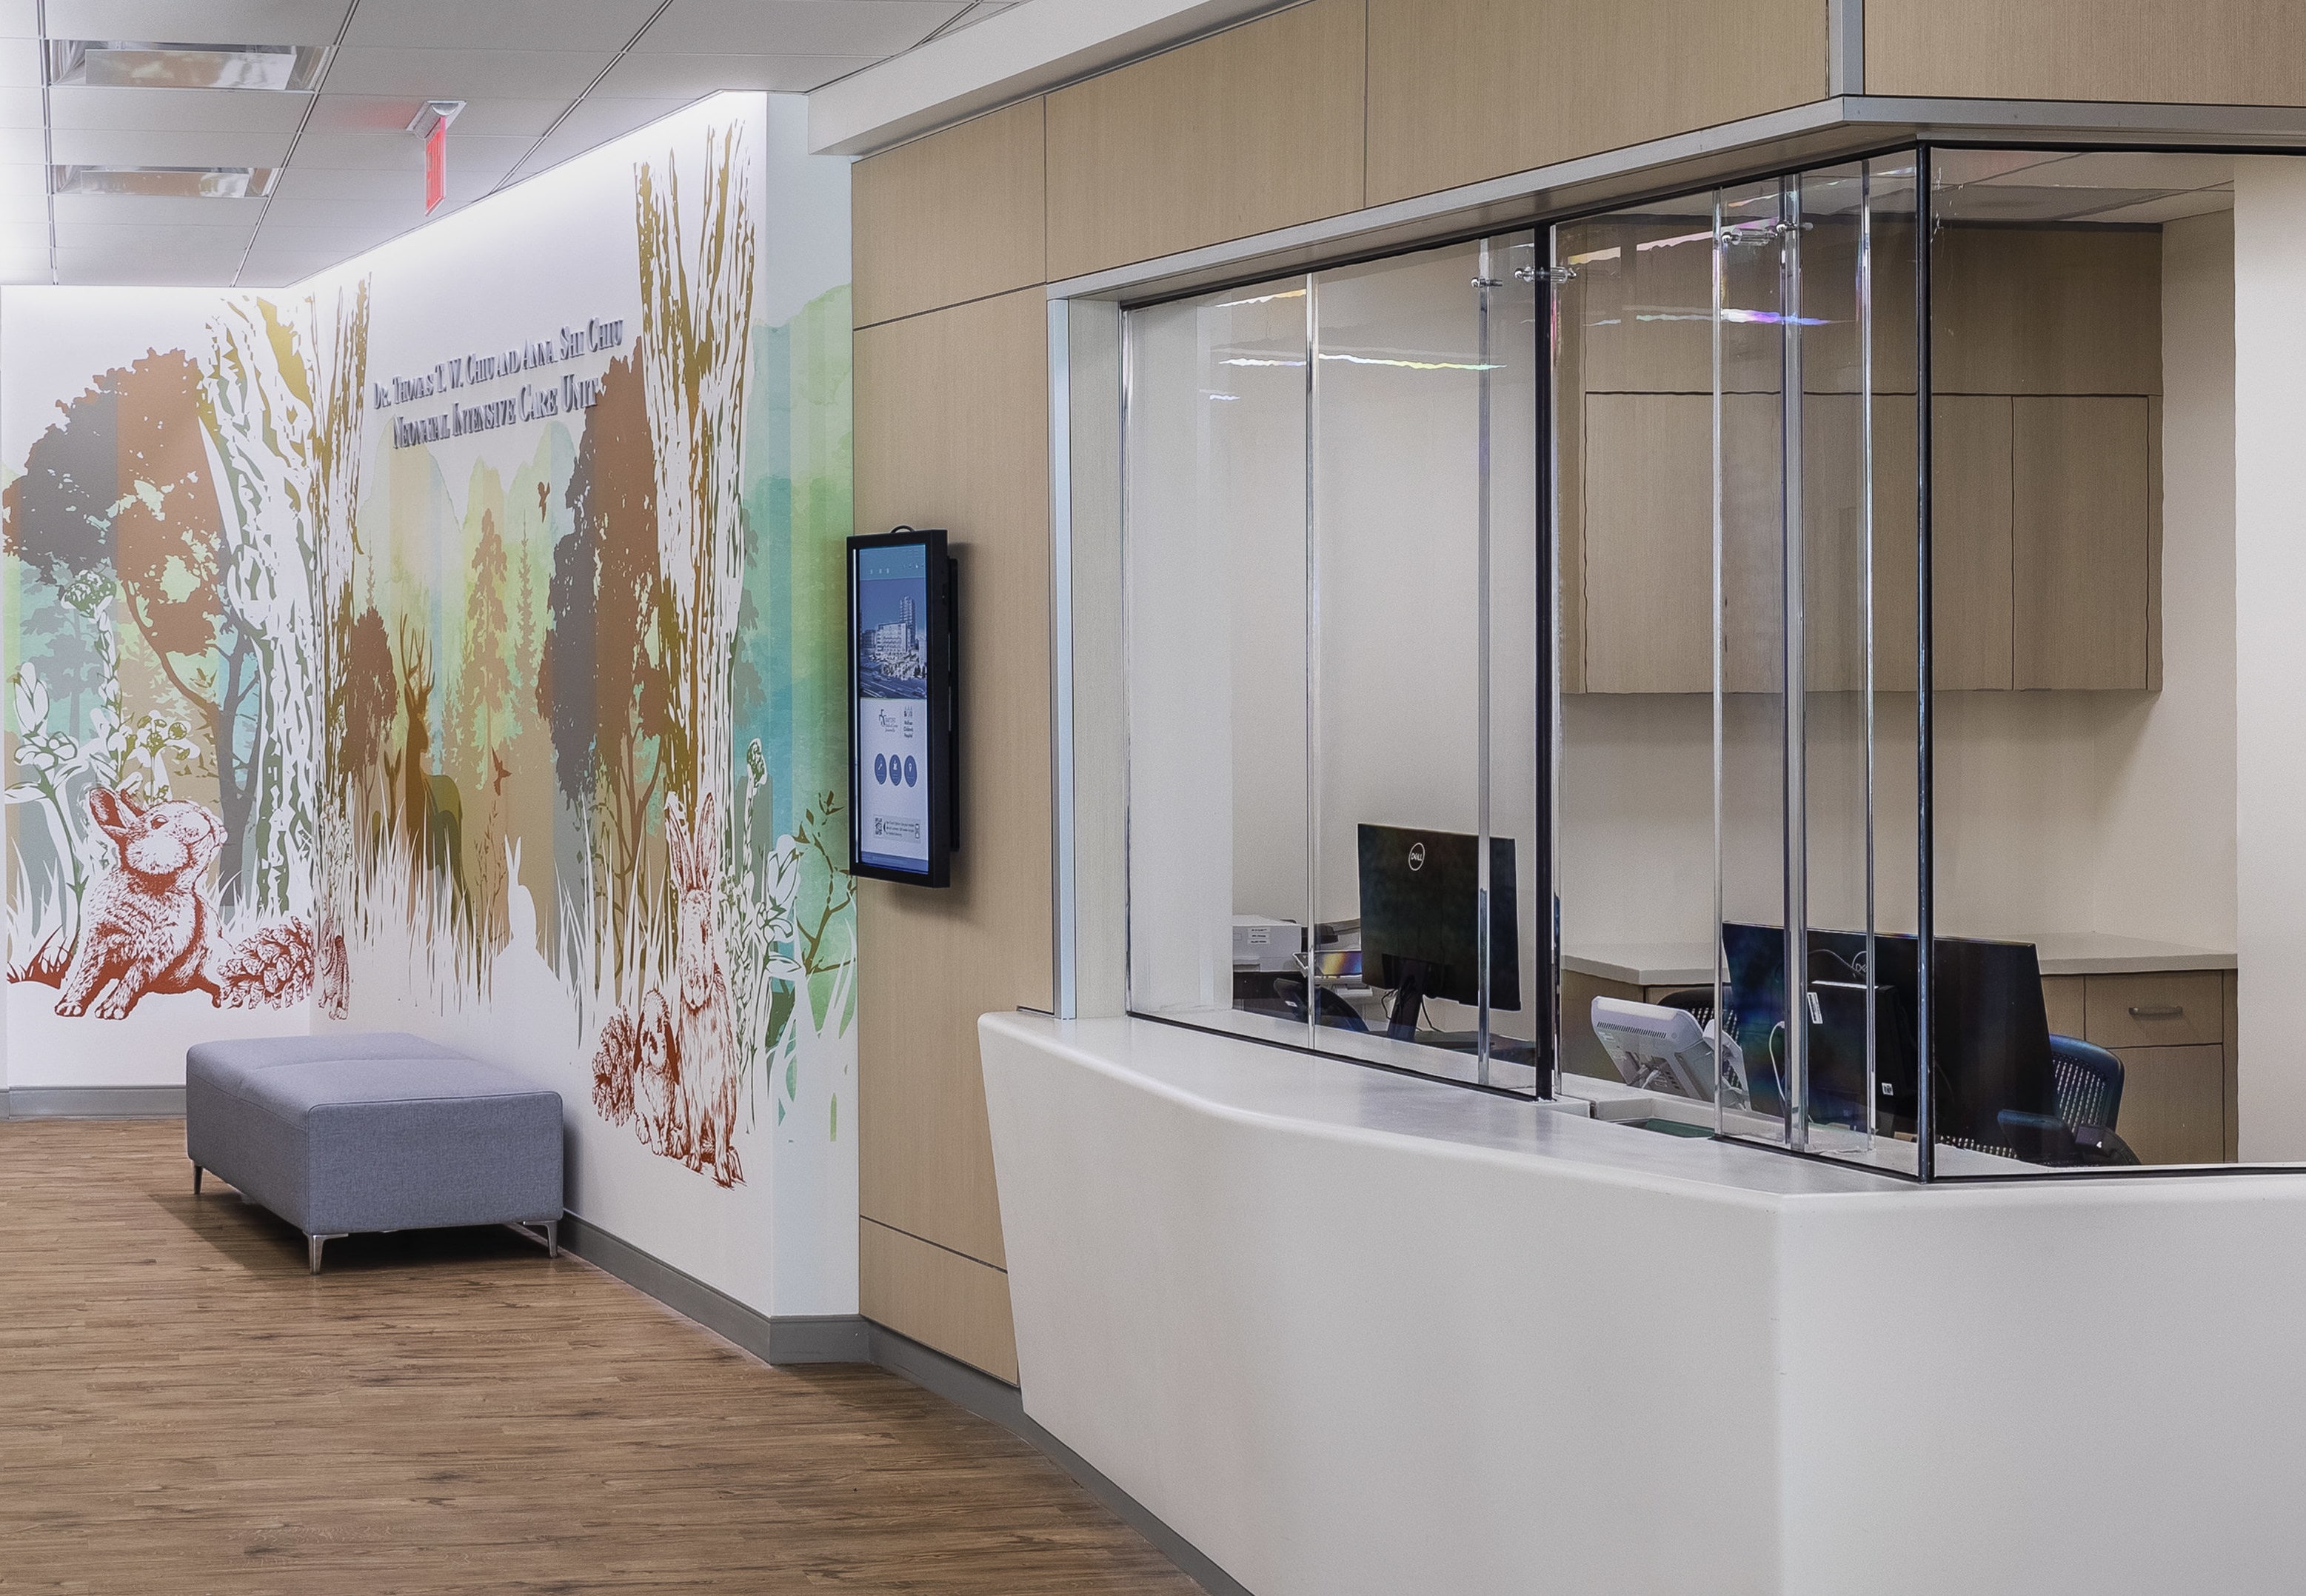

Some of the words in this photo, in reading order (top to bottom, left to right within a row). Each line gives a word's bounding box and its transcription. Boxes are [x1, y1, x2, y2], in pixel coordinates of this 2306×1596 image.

[374, 381, 391, 410] DR.
[393, 375, 434, 404] THOMAS
[448, 358, 464, 389] W.
[467, 353, 495, 385] CHIU
[497, 350, 520, 378] AND
[523, 338, 558, 369] ANNA
[587, 317, 624, 353] CHIU
[392, 413, 450, 450] NEONATAL
[452, 397, 516, 437] INTENSIVE
[519, 384, 558, 422] CARE
[561, 373, 599, 413] UNIT
[1410, 852, 1423, 861] DELL
